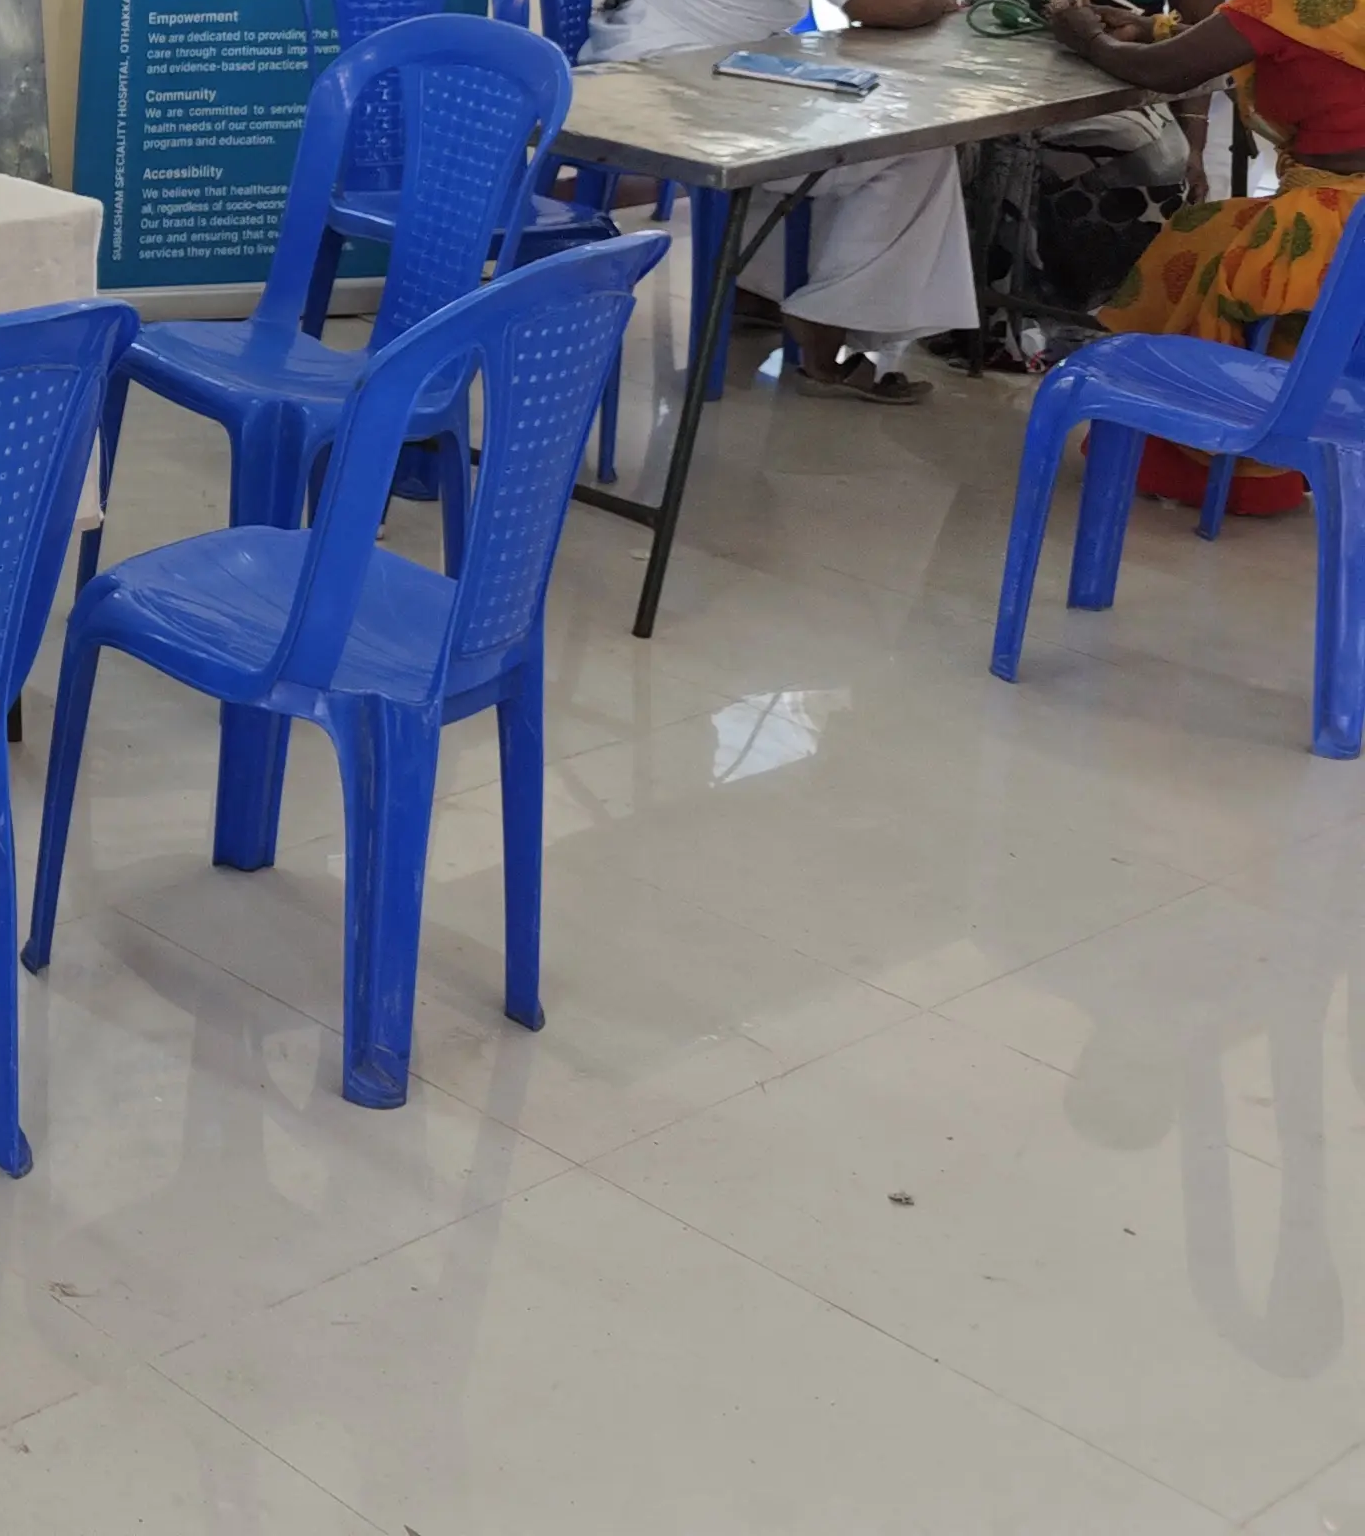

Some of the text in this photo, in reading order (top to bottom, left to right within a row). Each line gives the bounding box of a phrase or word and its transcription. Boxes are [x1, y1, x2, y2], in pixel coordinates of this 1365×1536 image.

[148, 10, 239, 27] Empowerment
[147, 32, 166, 44] We
[168, 32, 184, 43] are
[186, 30, 241, 43] dedicated
[243, 30, 256, 41] to
[257, 28, 307, 43] providing
[146, 49, 171, 60] care
[175, 45, 217, 60] through
[220, 44, 283, 57] continuous
[146, 62, 167, 74] and
[169, 60, 256, 74] evidence-based
[117, 56, 131, 118] HOSPITAL,
[145, 87, 217, 103] Community
[144, 107, 162, 119] We
[166, 107, 184, 118] are
[188, 104, 248, 117] committed
[253, 104, 265, 116] to
[144, 122, 176, 134] health
[178, 120, 212, 133] needs
[214, 119, 228, 131] of
[228, 120, 246, 131] our
[142, 133, 276, 151] programs and education.
[114, 120, 127, 189] SPECIALITY
[142, 165, 224, 181] Accessibility
[141, 184, 288, 200] We believe that healthcare
[157, 200, 209, 216] regardless
[212, 200, 223, 211] of
[111, 190, 125, 261] SUBIKSHAM
[140, 214, 278, 230] Our brand is dedicated to
[139, 233, 164, 245] care
[166, 231, 187, 243] and
[190, 230, 239, 244] ensuring
[242, 229, 264, 241] that
[138, 242, 275, 260] services they need to live
